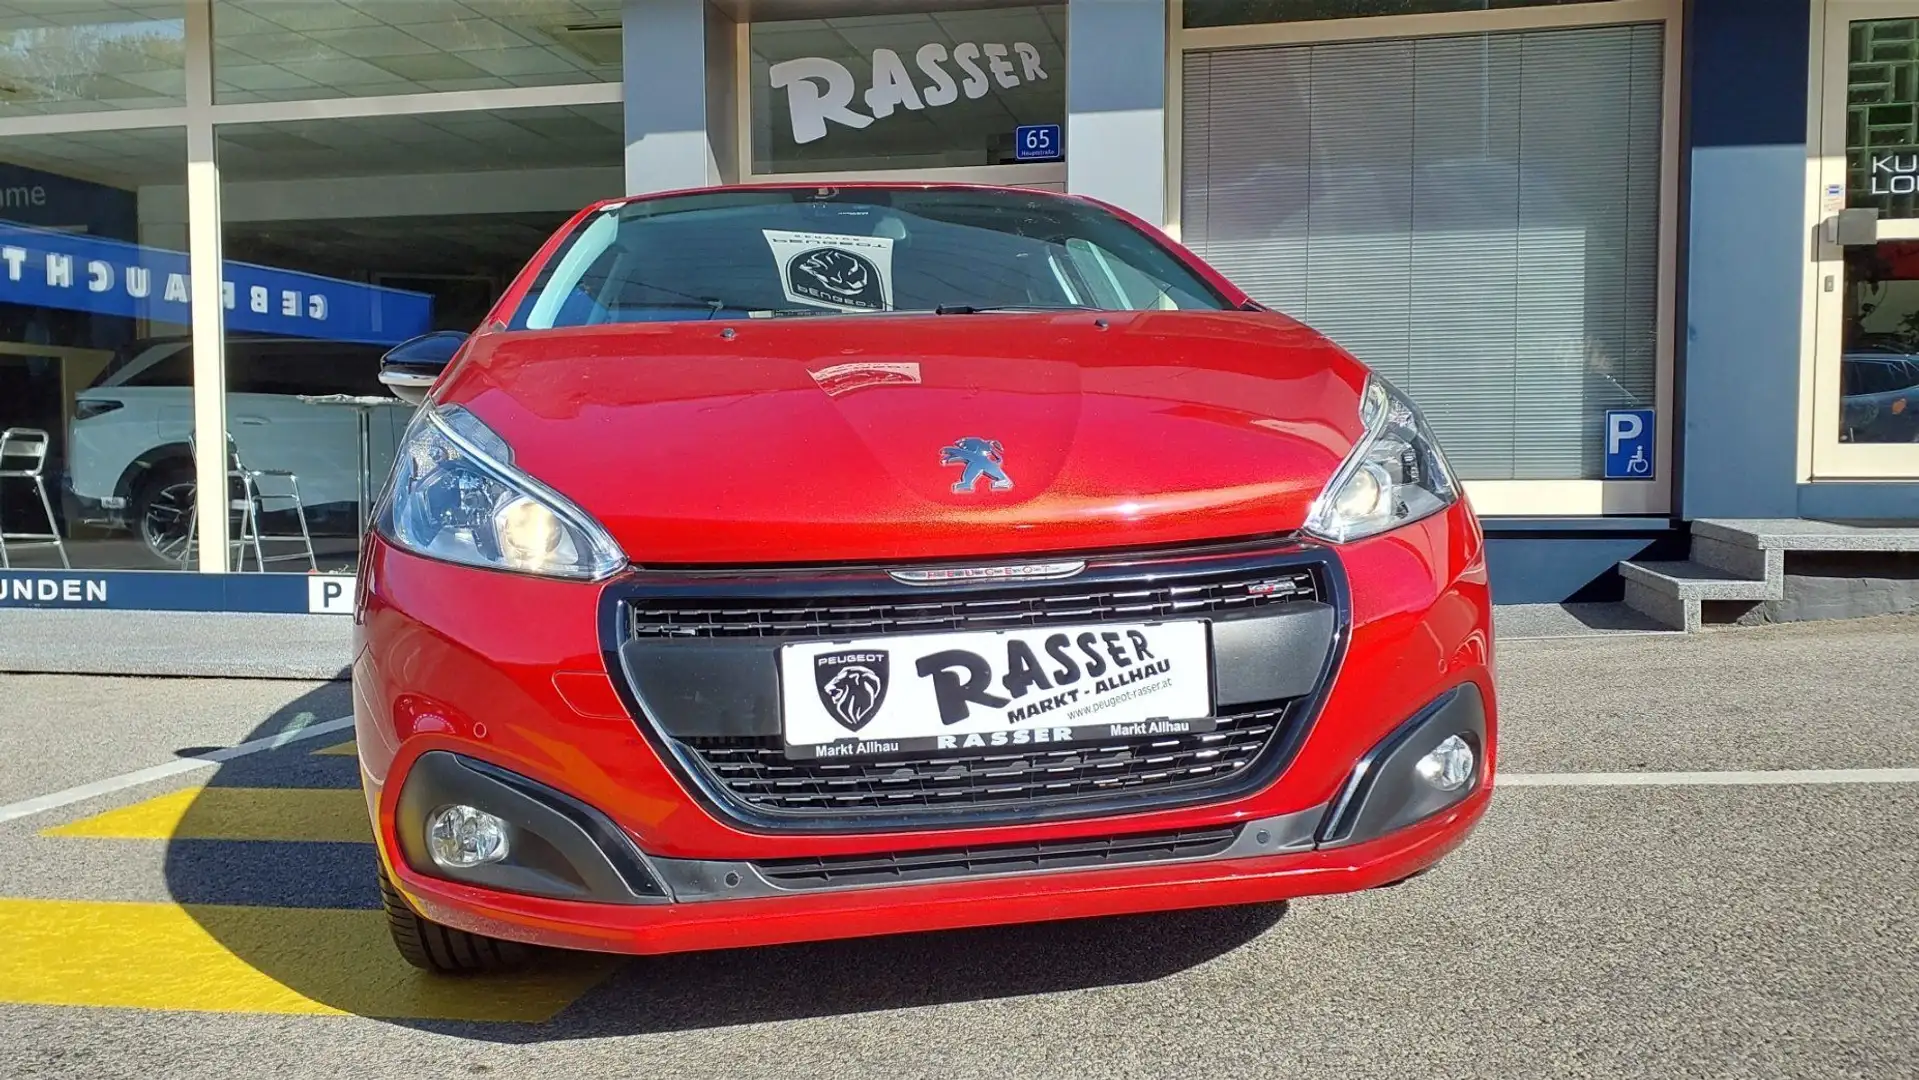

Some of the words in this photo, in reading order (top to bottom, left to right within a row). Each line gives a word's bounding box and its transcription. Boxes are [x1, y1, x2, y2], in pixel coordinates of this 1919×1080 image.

[769, 42, 1048, 143] RASSER
[1026, 129, 1050, 149] 65
[1872, 175, 1919, 194] LO
[1609, 413, 1643, 454] P
[927, 565, 1051, 579] PEUGEOT
[818, 654, 884, 666] PEUGEOT
[915, 629, 1155, 726] RASSER
[1007, 688, 1079, 724] MARKT
[1095, 658, 1171, 695] ALLHAU
[1067, 677, 1173, 720] www.peugeot-rasser.at
[937, 726, 1073, 749] RASSER
[1110, 722, 1146, 736] Markt
[1149, 720, 1190, 734] Allhau
[816, 744, 853, 757] Markt
[856, 742, 899, 754] Allhau
